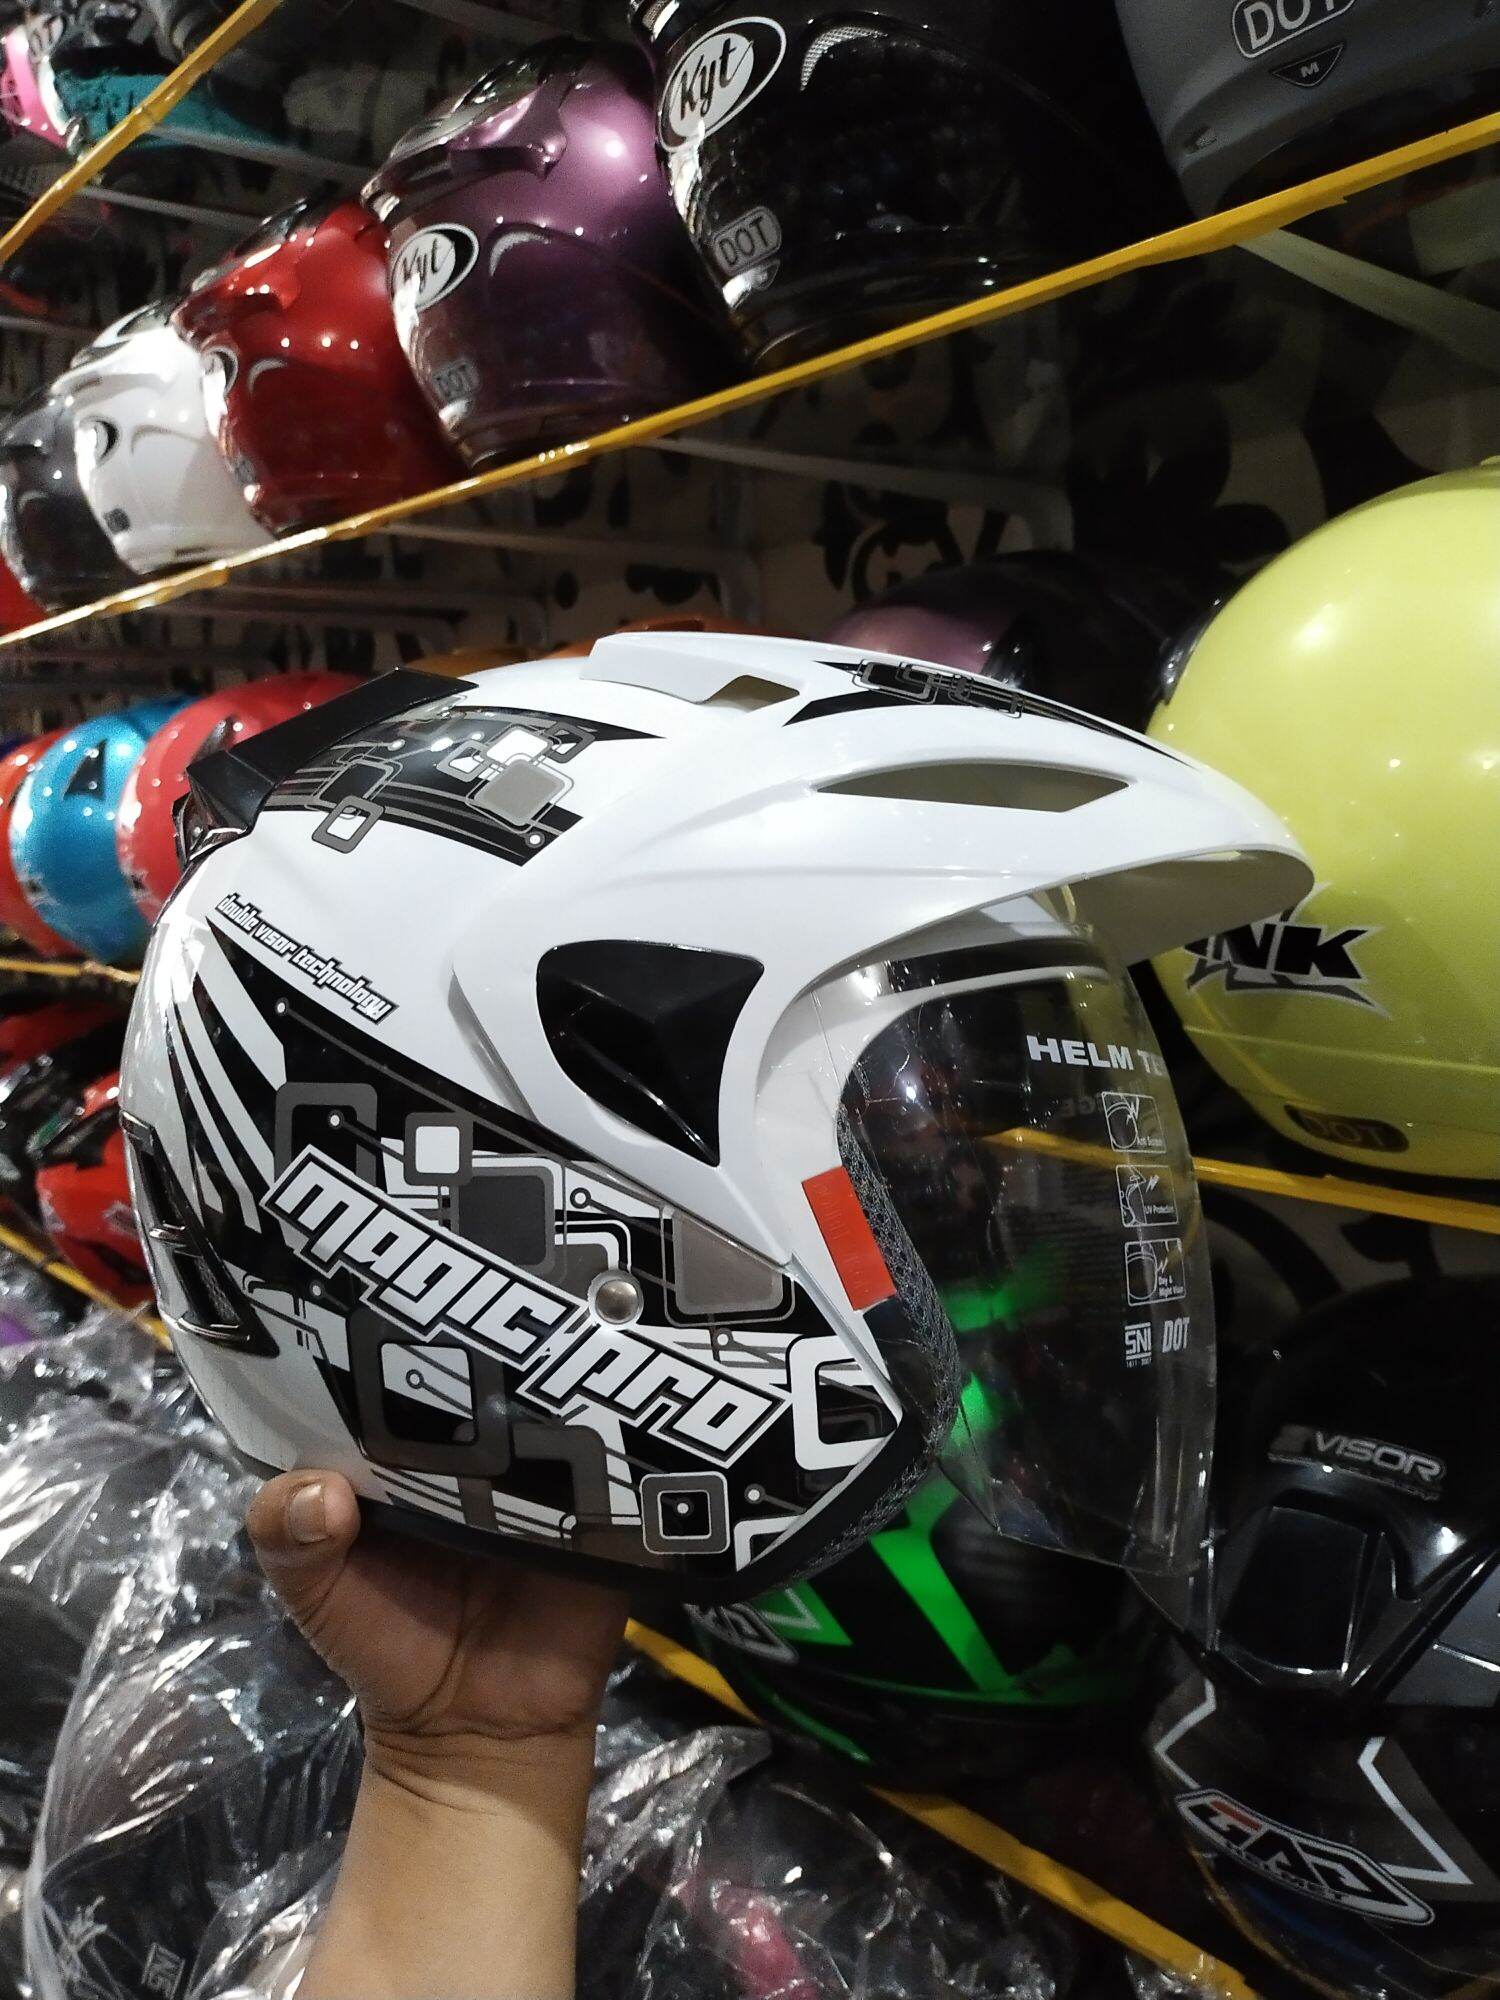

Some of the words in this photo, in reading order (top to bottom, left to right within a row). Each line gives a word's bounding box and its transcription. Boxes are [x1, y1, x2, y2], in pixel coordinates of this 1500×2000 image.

[1243, 0, 1336, 49] DO
[1300, 62, 1319, 78] M
[718, 216, 770, 268] DOT
[1026, 1035, 1134, 1071] HELM
[1125, 1326, 1152, 1355] SNI
[1162, 1317, 1190, 1354] DOT
[1315, 1430, 1443, 1482] VISOR
